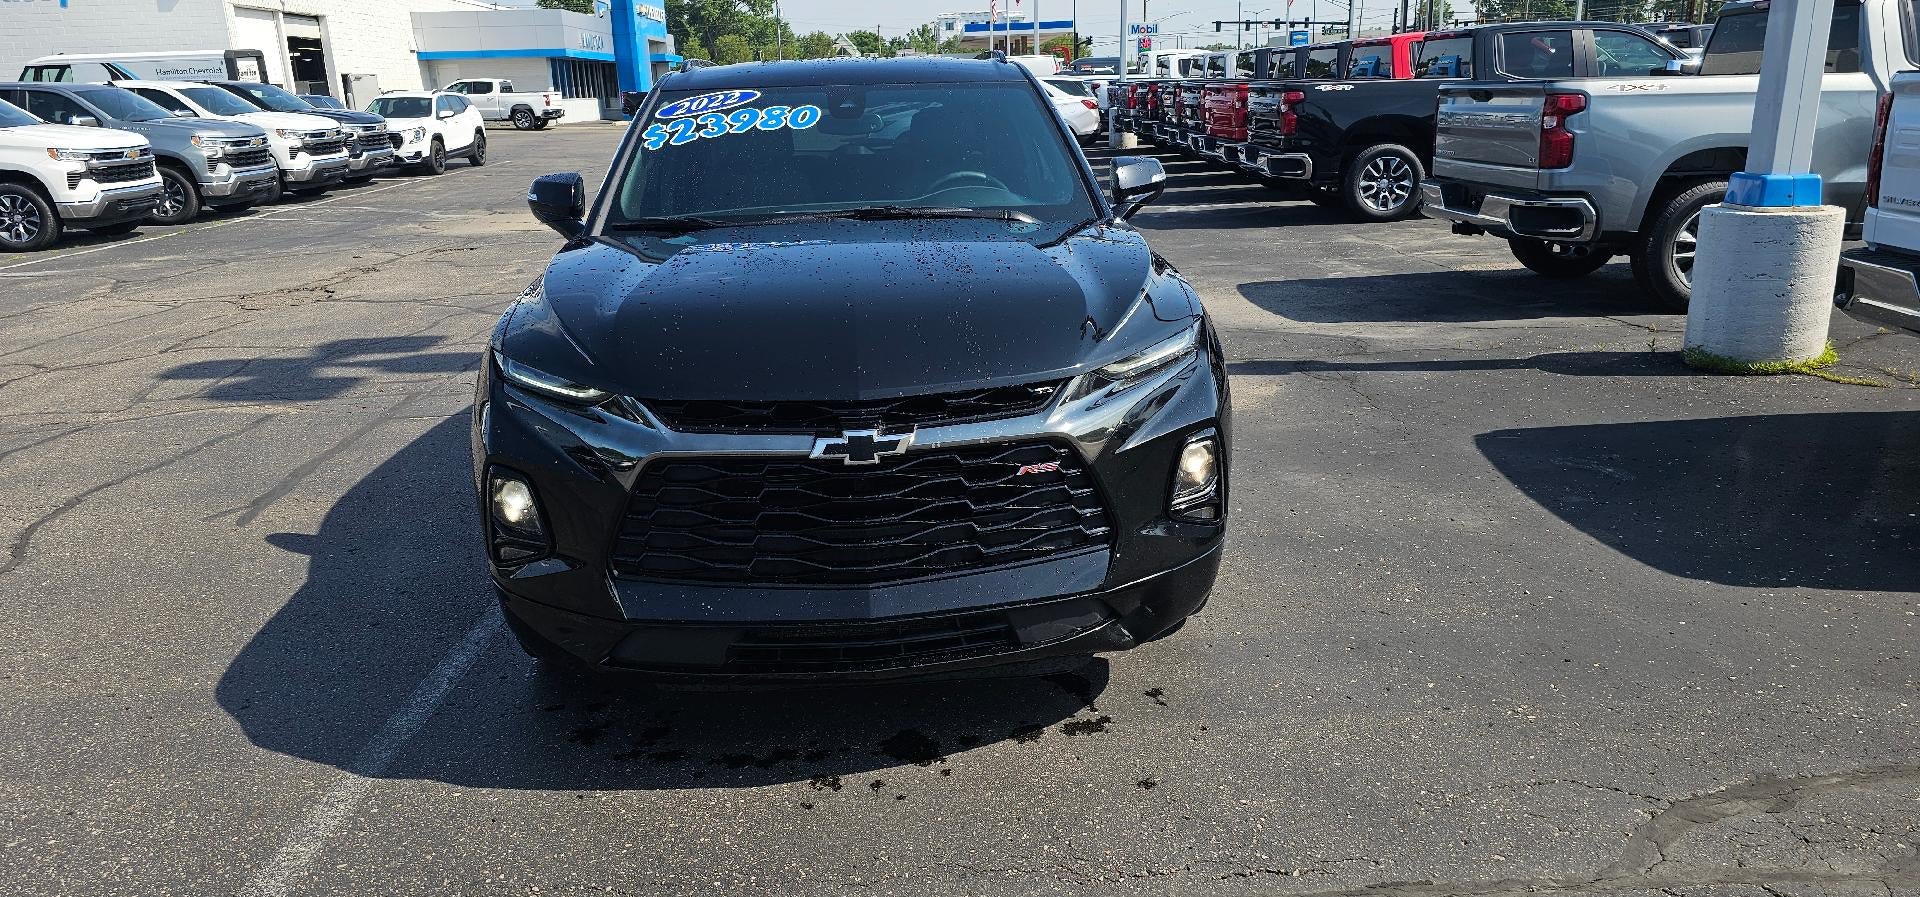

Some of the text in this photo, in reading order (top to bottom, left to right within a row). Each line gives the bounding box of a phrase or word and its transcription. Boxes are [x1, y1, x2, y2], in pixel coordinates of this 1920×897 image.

[1131, 24, 1158, 34] Mobil
[156, 67, 222, 76] Hamilton Chevrolet
[673, 91, 741, 116] 2022
[642, 104, 821, 150] $23980
